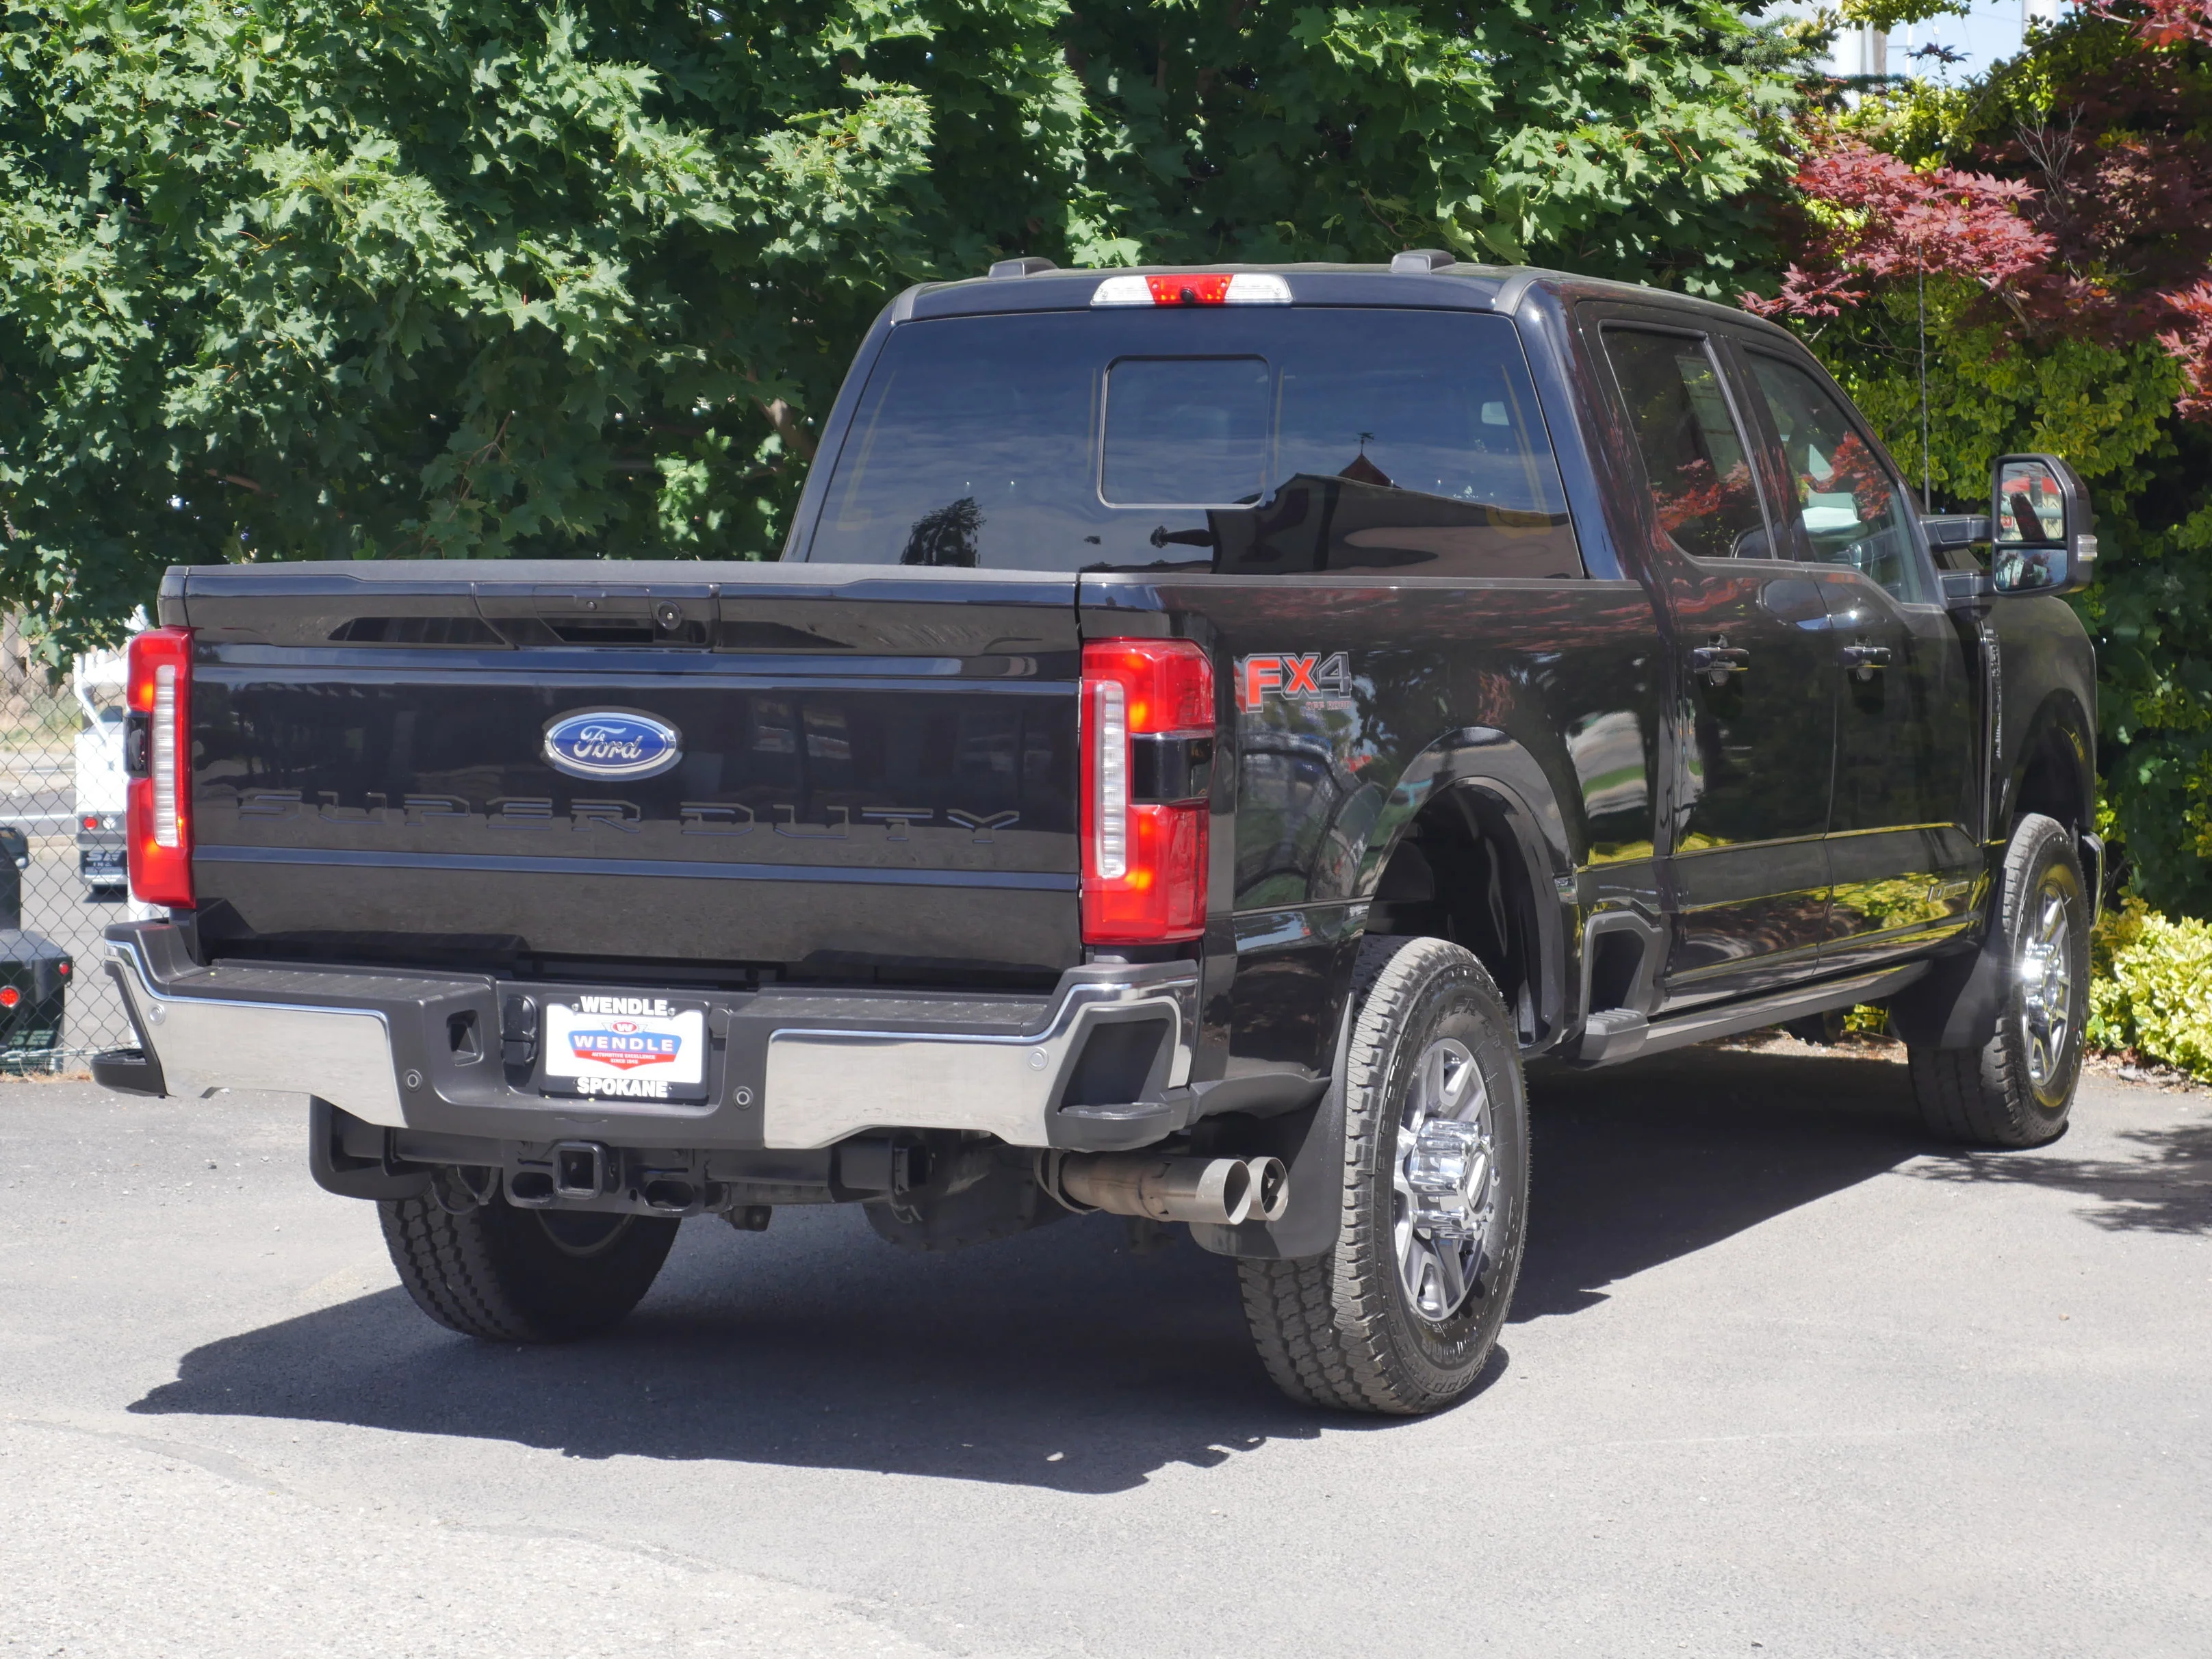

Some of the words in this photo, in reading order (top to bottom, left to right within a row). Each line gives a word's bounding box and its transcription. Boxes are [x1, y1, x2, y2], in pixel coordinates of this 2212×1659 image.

[1244, 652, 1352, 713] FX4
[574, 725, 643, 758] Ford
[237, 788, 640, 834] SUPER
[680, 801, 1020, 844] DUTY
[580, 996, 667, 1016] WENDLE
[574, 1036, 673, 1052] WENDLE
[577, 1077, 668, 1098] SPOKANE
